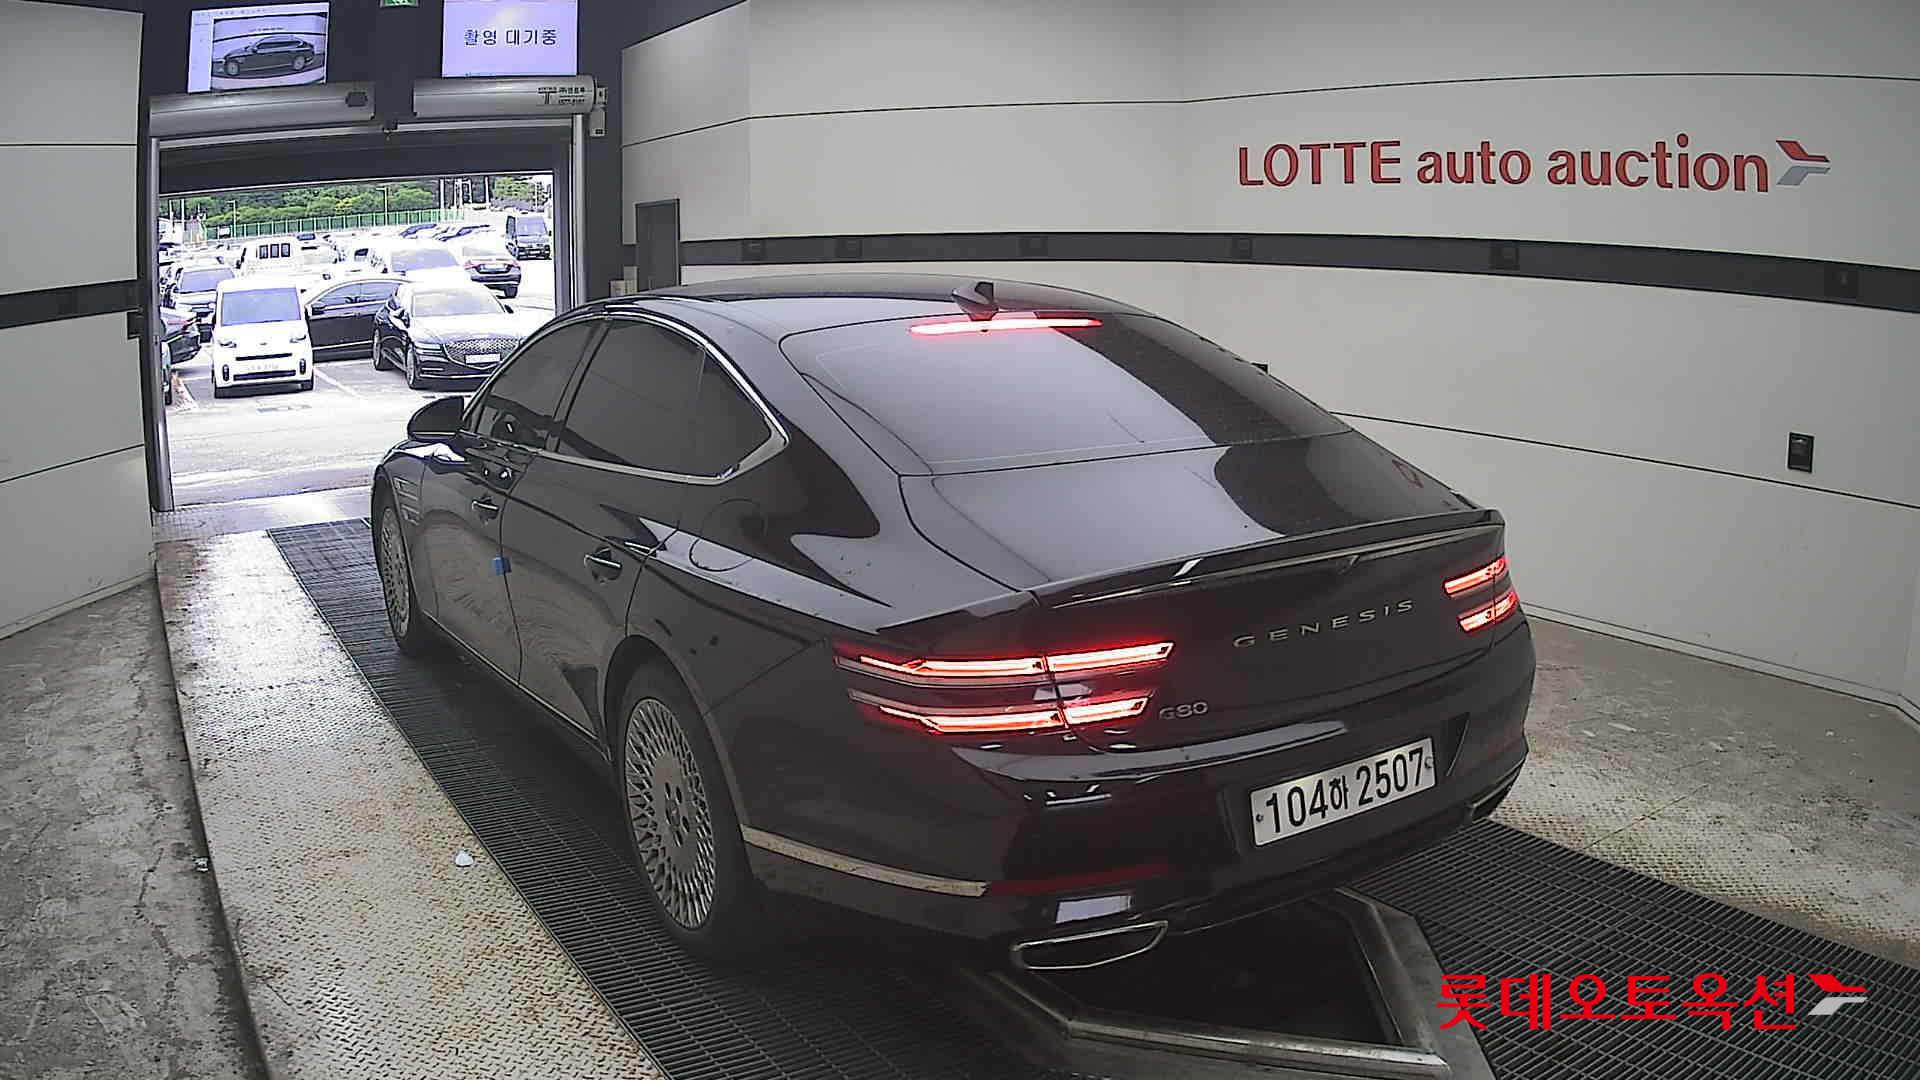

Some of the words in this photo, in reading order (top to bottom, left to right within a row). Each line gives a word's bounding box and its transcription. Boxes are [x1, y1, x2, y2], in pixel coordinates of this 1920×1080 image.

[506, 29, 557, 46] 대기중
[1238, 140, 1401, 187] LOTTE
[1416, 141, 1532, 185] auto
[1547, 132, 1769, 193] auction
[1233, 600, 1413, 648] GENESIS
[1159, 702, 1209, 720] G80
[1265, 774, 1349, 833] 104하
[1355, 747, 1424, 807] 2507
